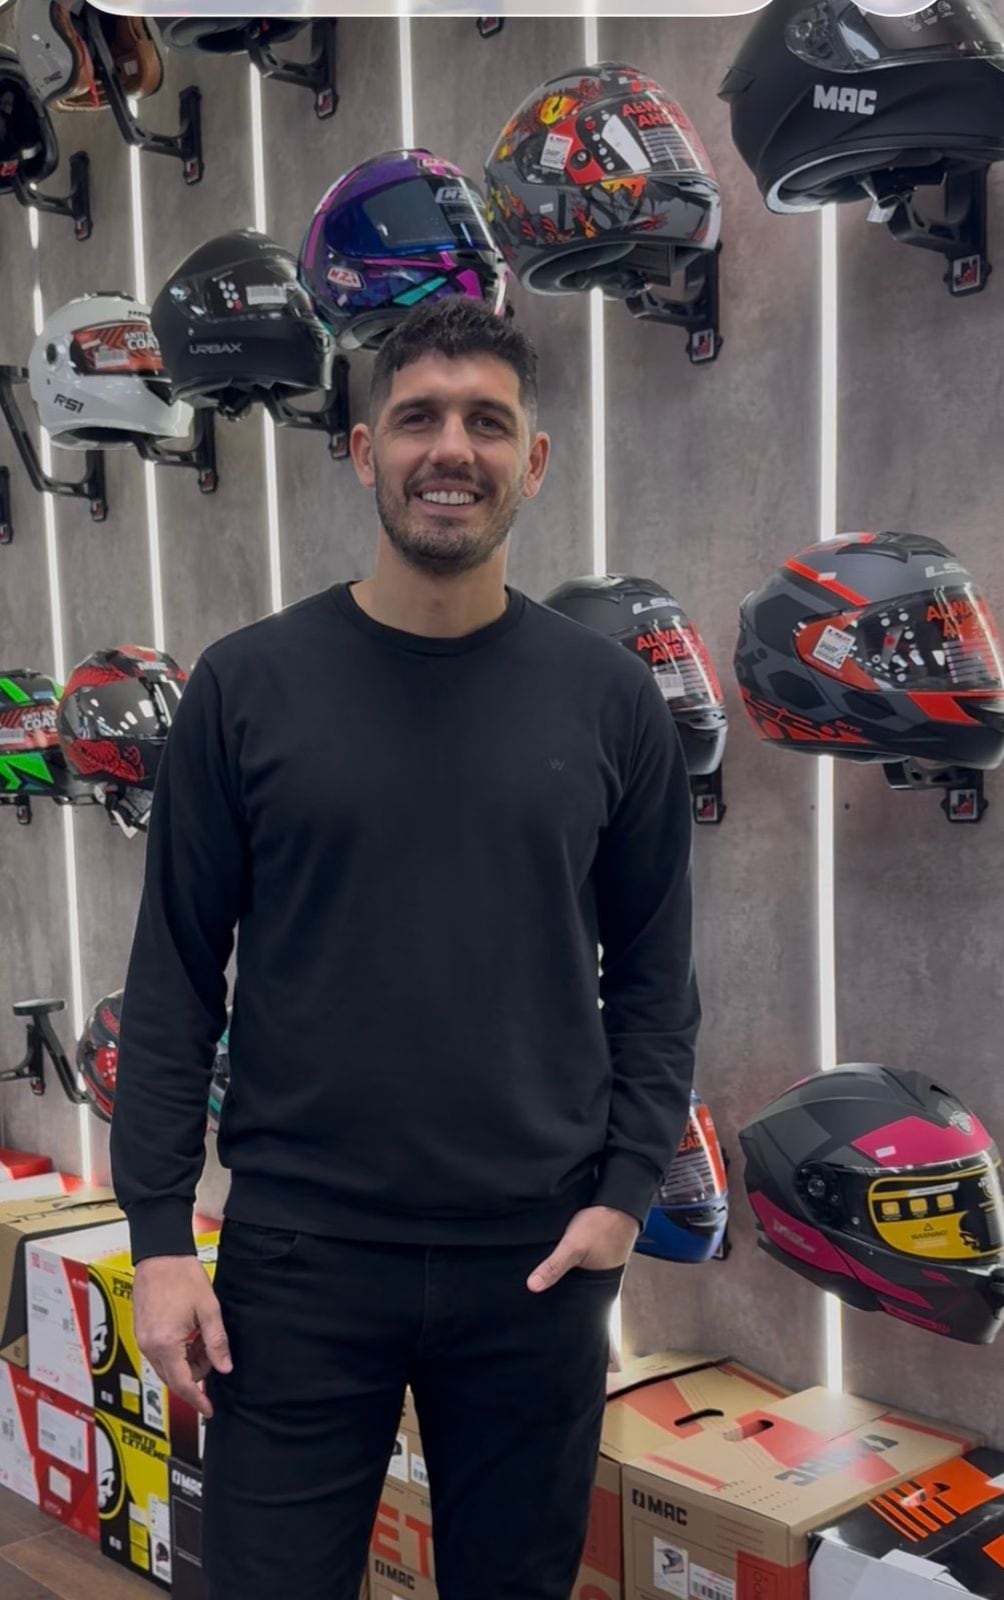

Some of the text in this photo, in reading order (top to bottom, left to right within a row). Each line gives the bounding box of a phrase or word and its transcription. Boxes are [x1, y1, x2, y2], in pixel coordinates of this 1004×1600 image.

[813, 84, 878, 115] MAC
[189, 344, 243, 354] URBAX
[647, 1497, 688, 1527] MAC
[386, 1565, 415, 1590] MAC
